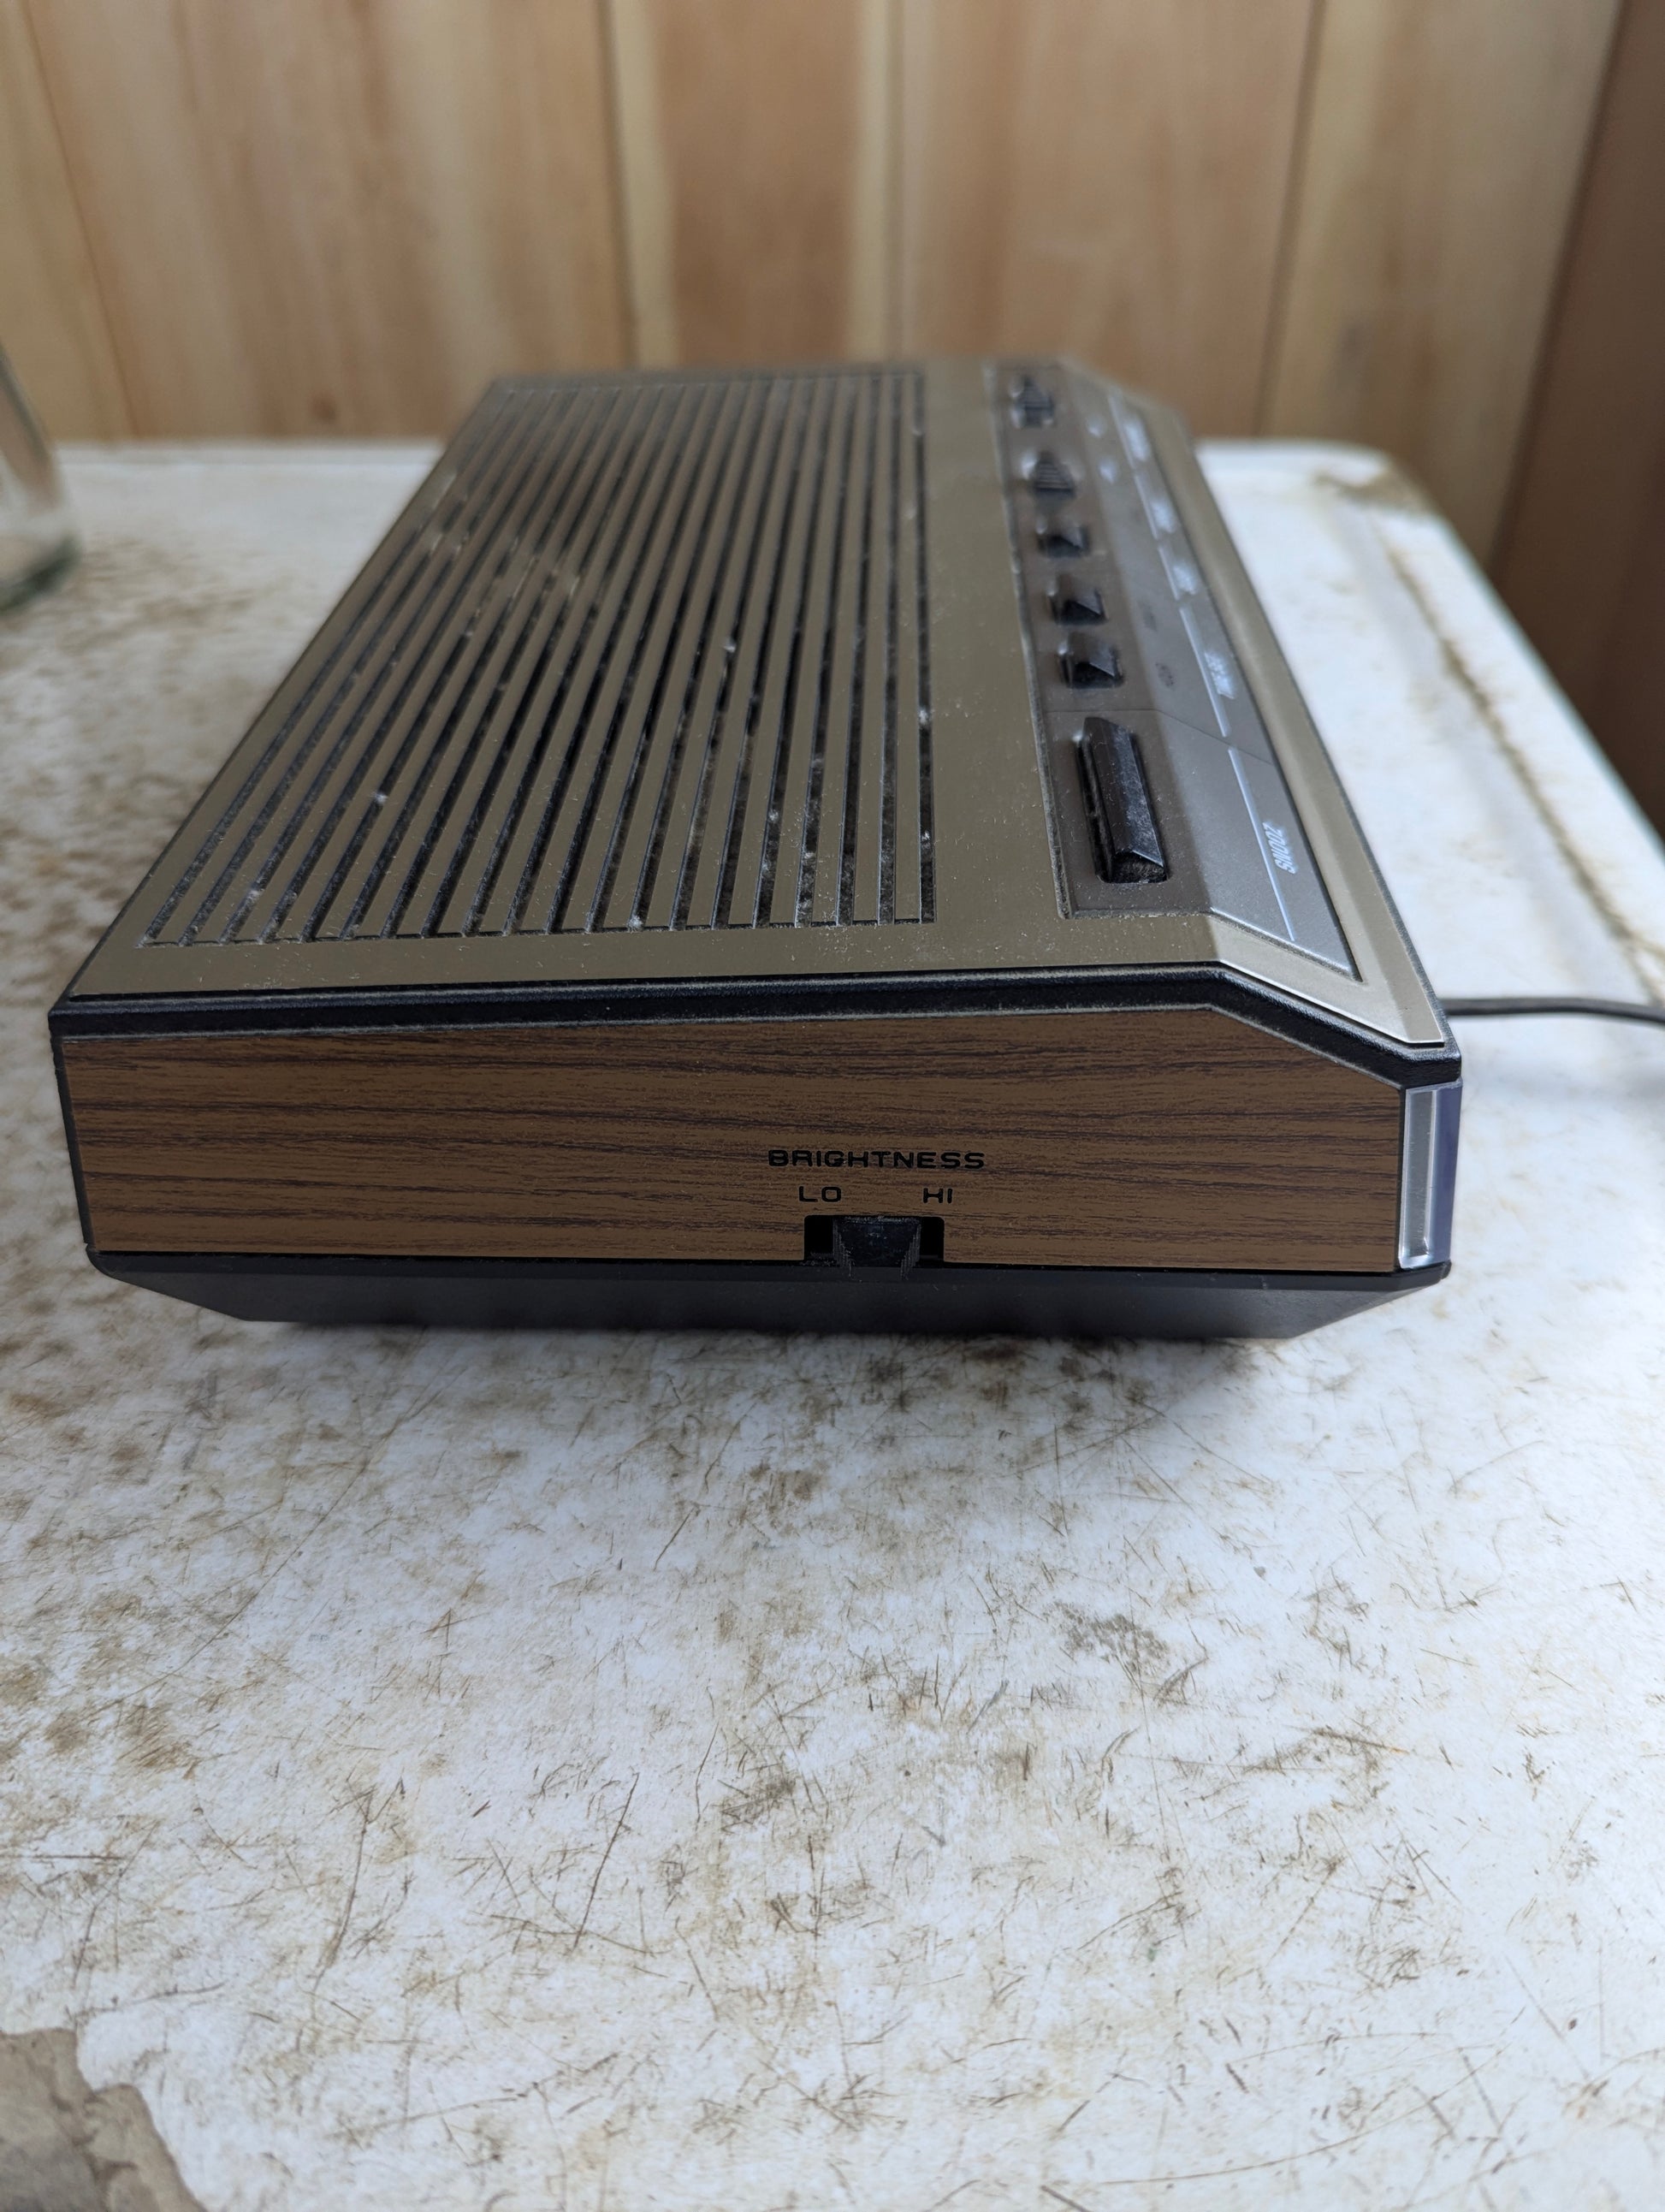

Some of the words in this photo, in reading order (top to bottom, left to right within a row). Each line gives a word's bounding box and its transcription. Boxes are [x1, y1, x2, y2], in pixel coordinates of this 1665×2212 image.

[767, 1148, 986, 1170] BRIGHTNESS
[797, 1185, 842, 1203] LO
[922, 1187, 953, 1204] HI
